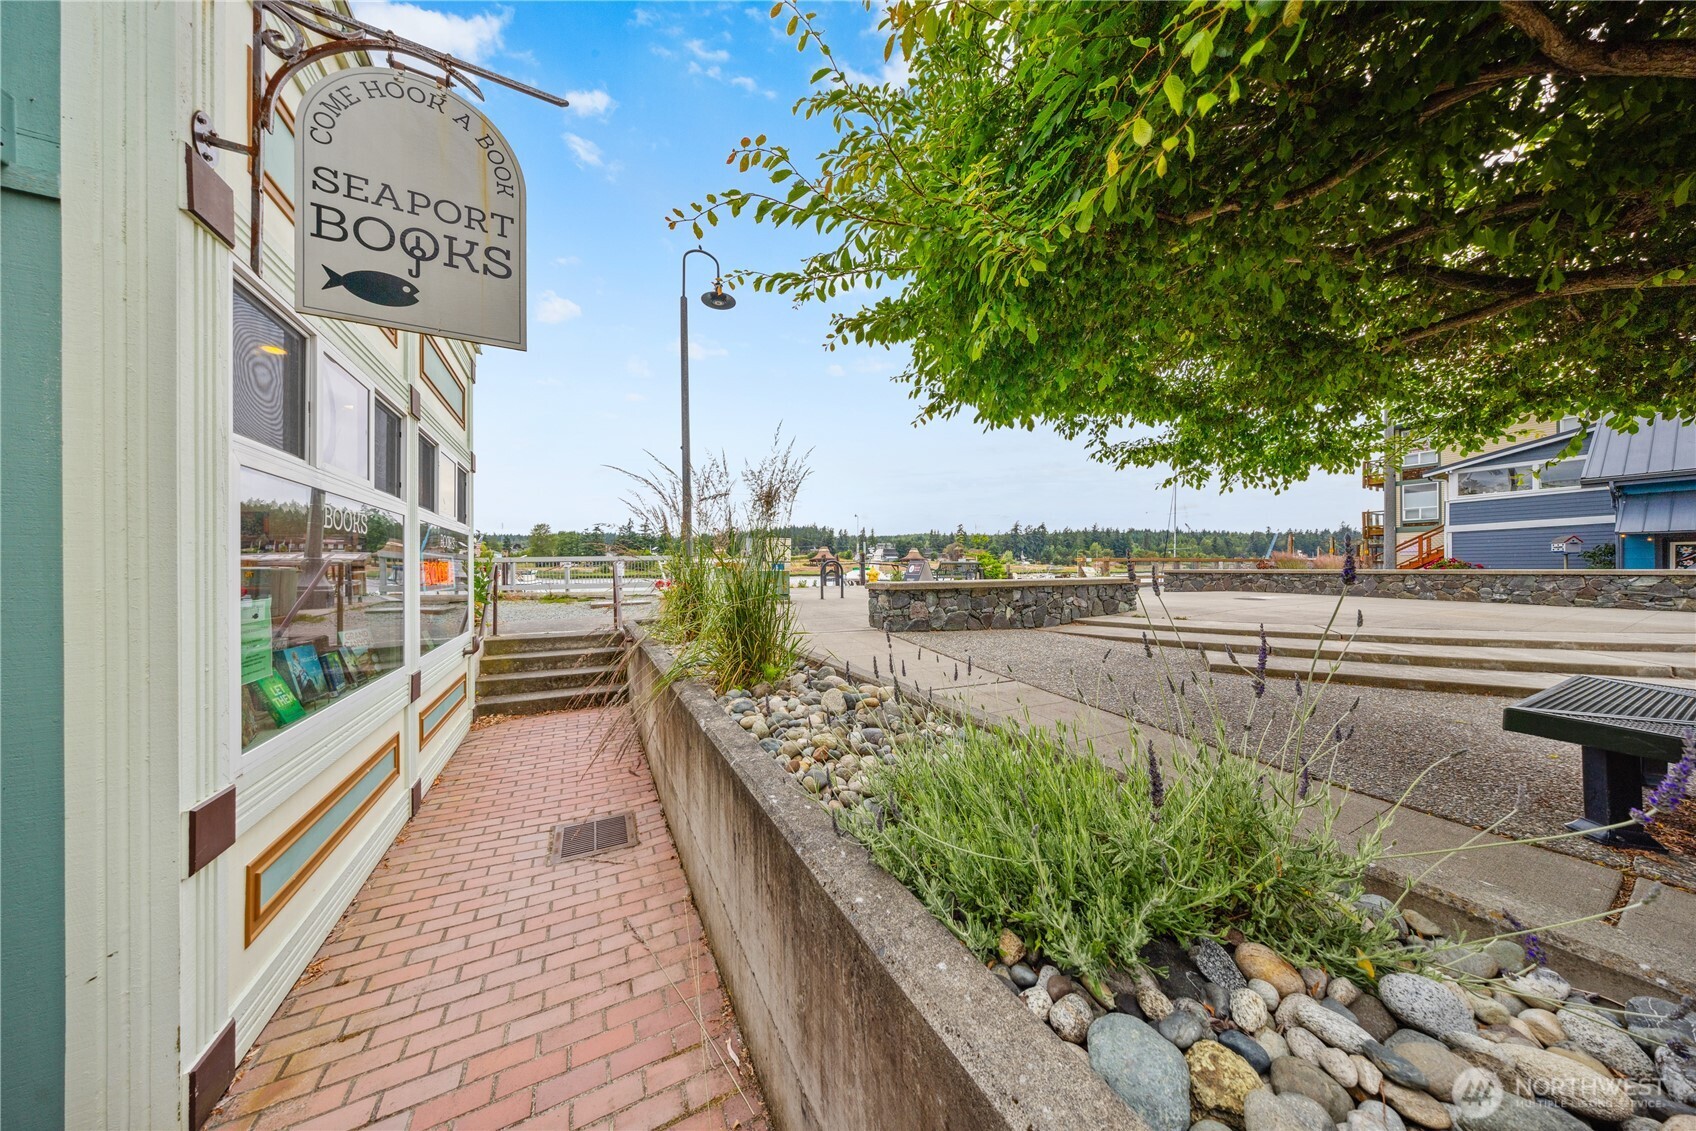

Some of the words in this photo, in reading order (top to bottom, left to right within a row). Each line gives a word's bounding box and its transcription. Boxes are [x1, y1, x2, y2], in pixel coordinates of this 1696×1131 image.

[310, 85, 361, 145] COME
[359, 80, 447, 115] HOOK
[453, 112, 472, 132] A
[474, 132, 515, 199] BOOK
[312, 166, 514, 238] SEAPORT
[310, 202, 513, 280] BOOKS
[323, 503, 368, 535] BOOKS
[344, 630, 369, 640] GRAND
[269, 684, 285, 697] LET
[271, 692, 297, 707] THEM
